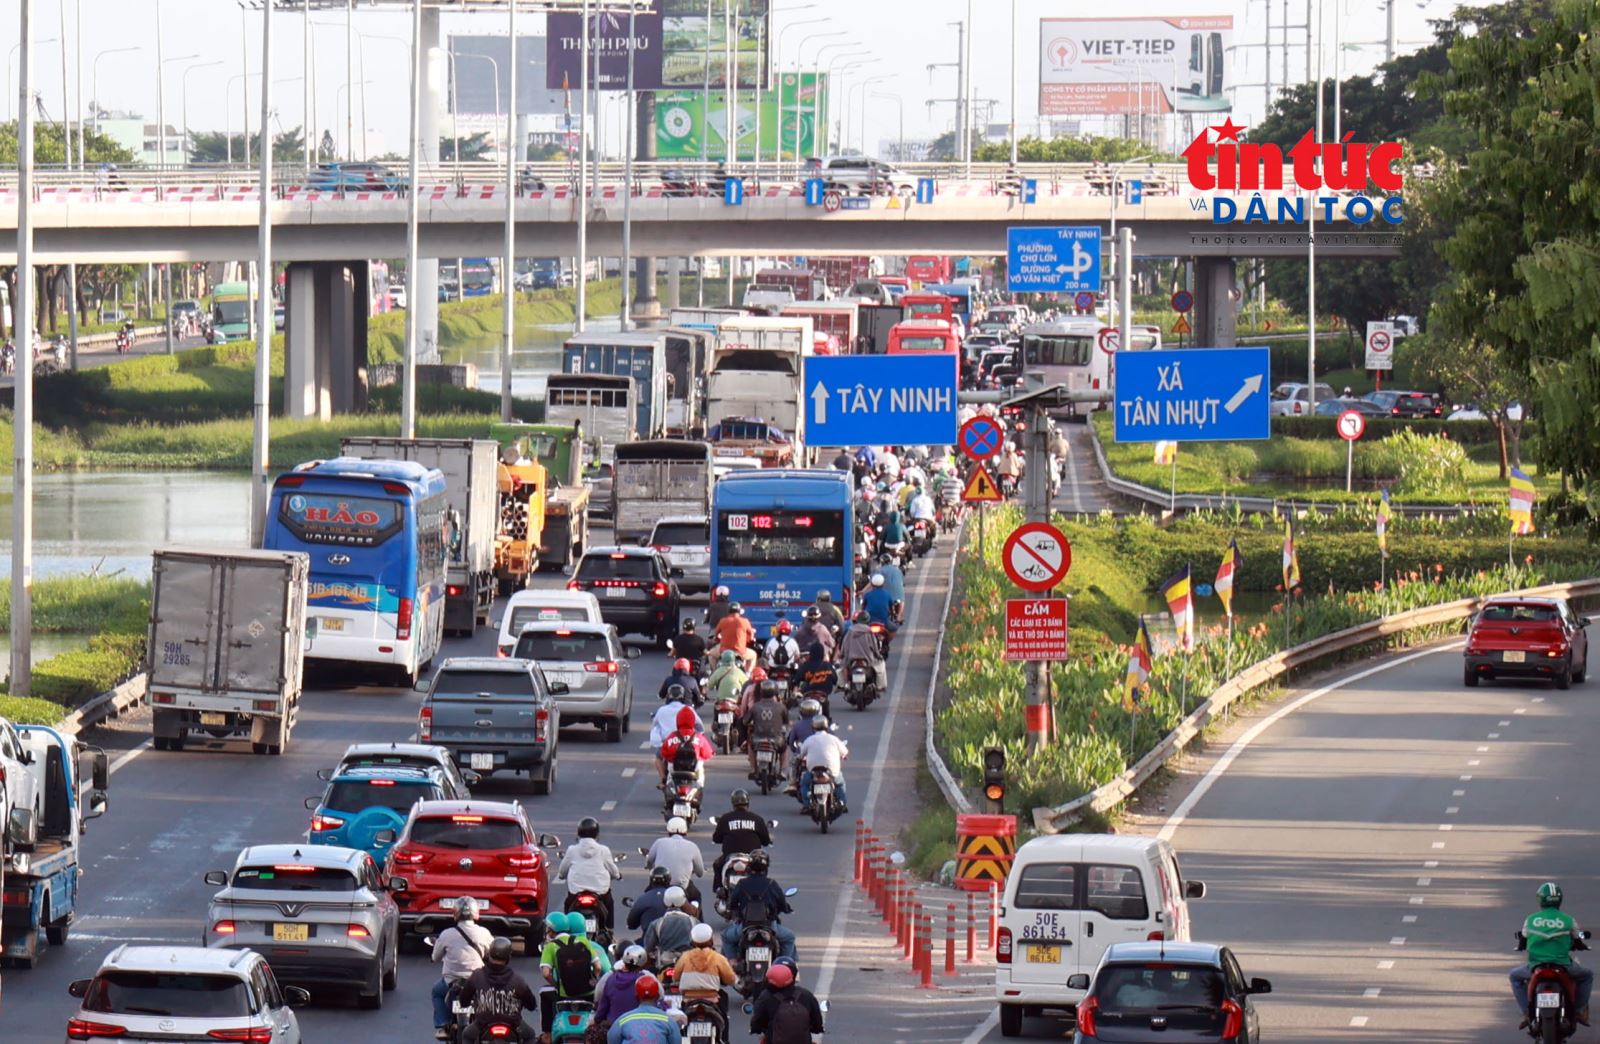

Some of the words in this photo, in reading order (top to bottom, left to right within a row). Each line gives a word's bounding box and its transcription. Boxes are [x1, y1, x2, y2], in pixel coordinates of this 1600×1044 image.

[1157, 362, 1184, 392] XÃ
[837, 384, 883, 414] TÂY
[890, 387, 951, 413] NINH
[1121, 396, 1160, 426] TÂN
[1165, 397, 1220, 430] NHỰT
[730, 516, 747, 528] 102
[752, 516, 771, 529] 102
[1024, 601, 1049, 615] CẤM
[163, 641, 182, 653] 50H
[162, 654, 191, 667] 29285
[728, 820, 741, 830] VIET
[741, 820, 755, 831] NAM
[1035, 912, 1059, 926] 50E
[1532, 917, 1565, 929] Grab
[1023, 925, 1066, 939] 861.54
